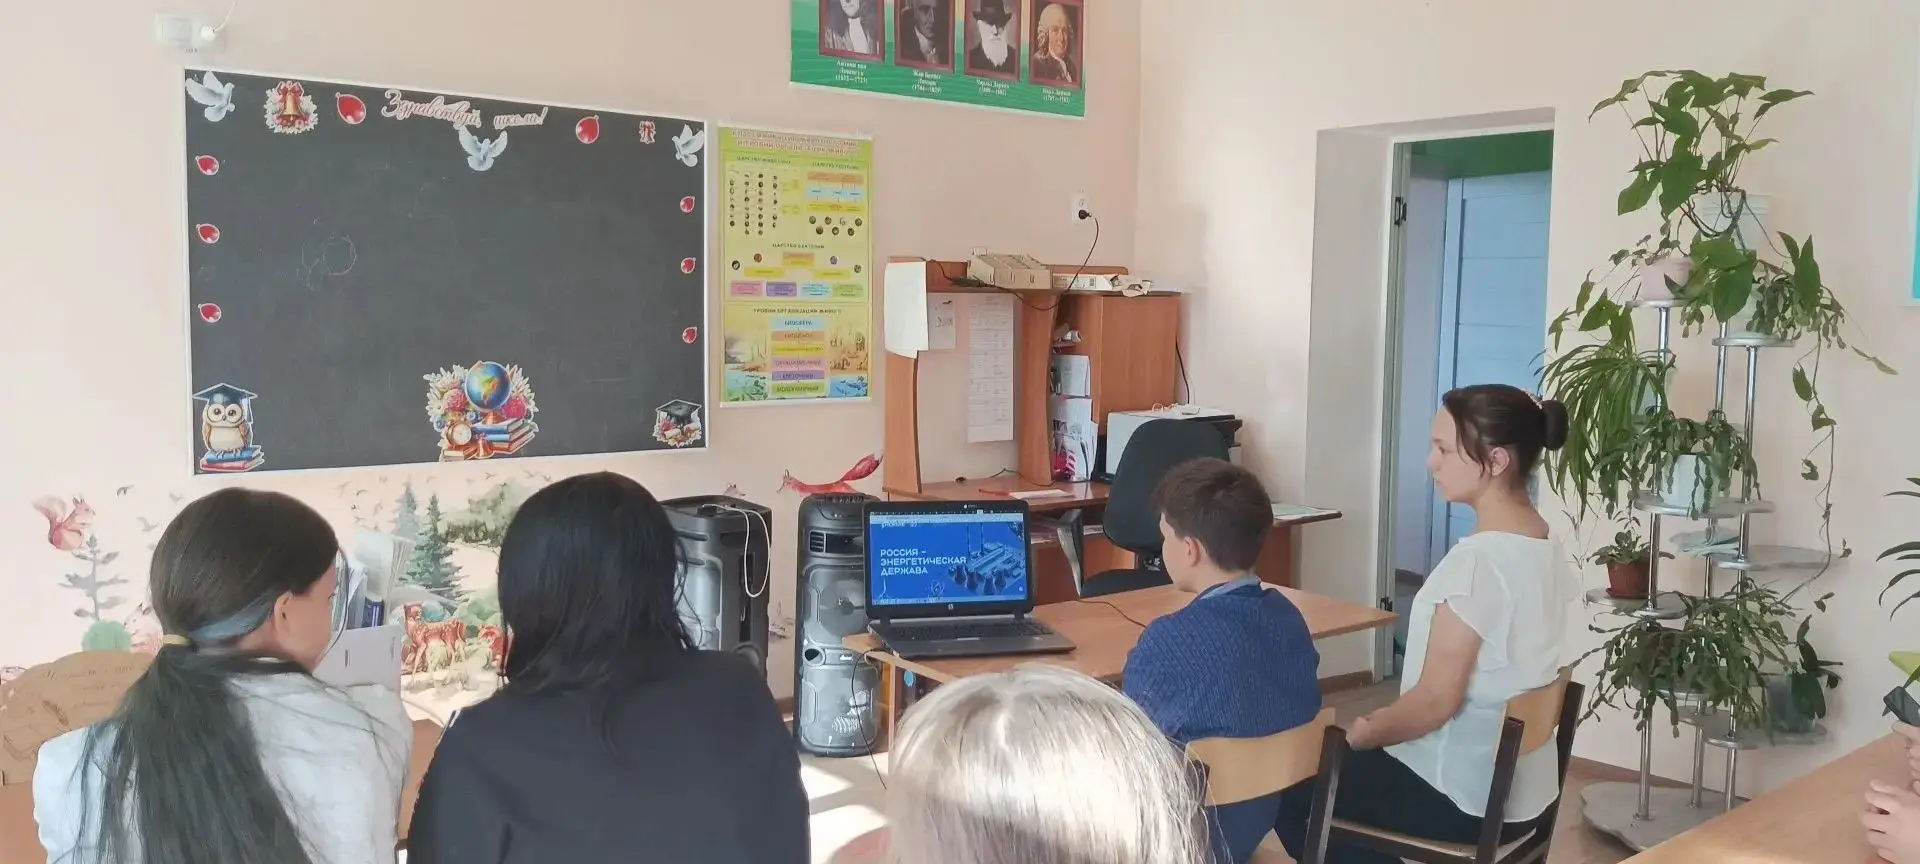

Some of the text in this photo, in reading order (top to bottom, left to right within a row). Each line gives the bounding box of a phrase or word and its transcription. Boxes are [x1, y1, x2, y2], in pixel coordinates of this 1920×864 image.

[880, 548, 919, 557] РОССИЯ
[880, 556, 967, 566] ЭНЕРГЕТИЧЕСКАЯ
[880, 566, 928, 576] ДЕРЖАВА
